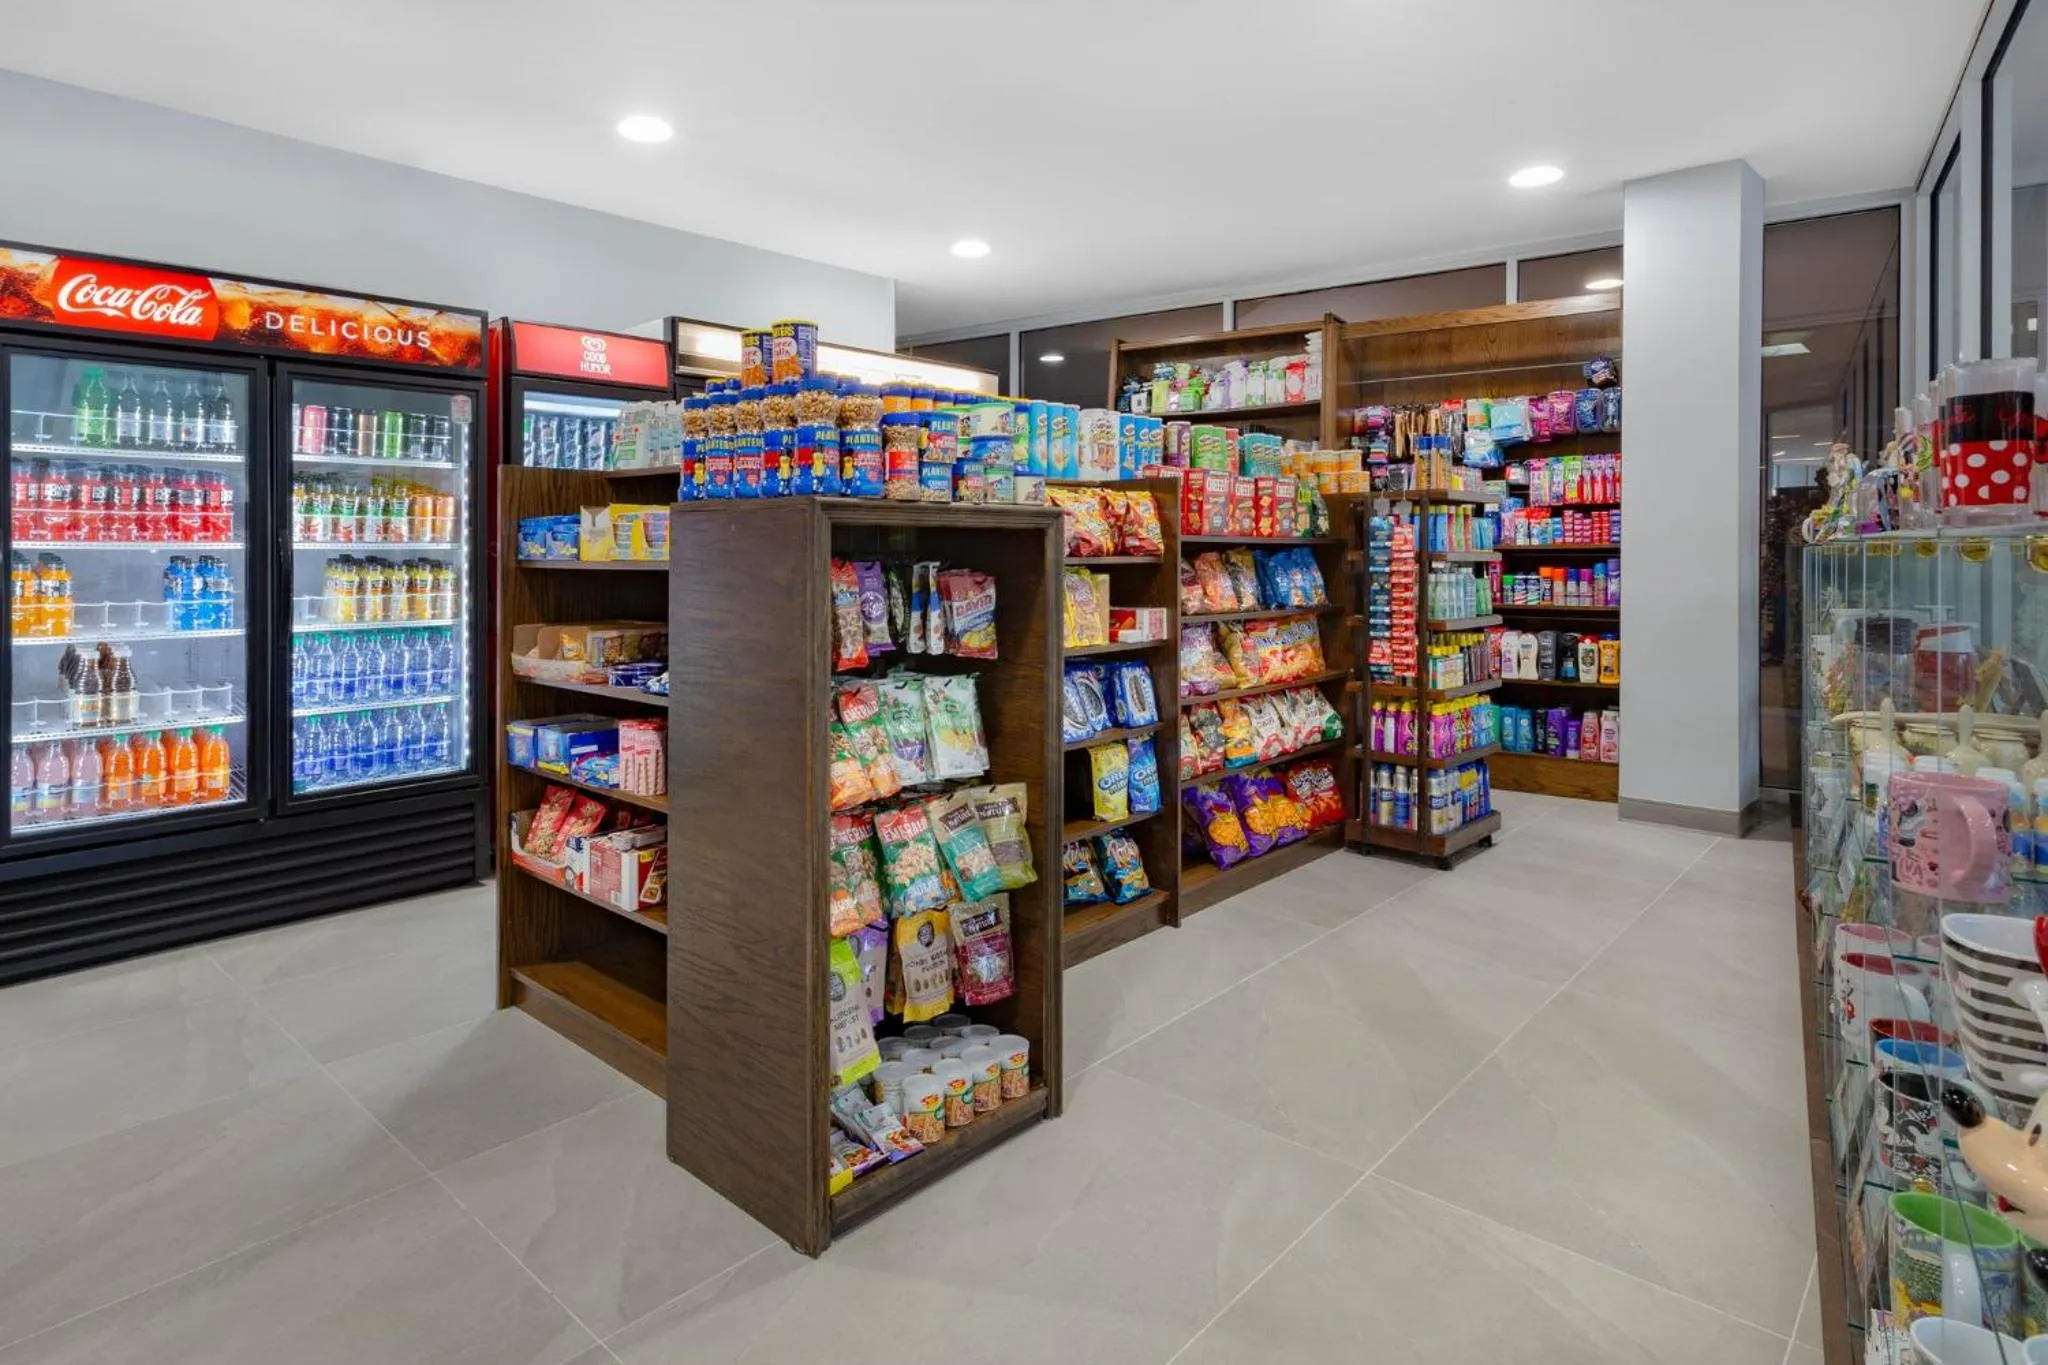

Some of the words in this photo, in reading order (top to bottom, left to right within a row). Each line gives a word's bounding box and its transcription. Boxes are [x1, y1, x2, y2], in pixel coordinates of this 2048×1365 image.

[57, 273, 212, 326] Coca-Cola
[264, 311, 432, 348] DELICIOUS
[579, 360, 613, 376] HUMOR
[583, 350, 607, 364] GOOD
[954, 594, 992, 618] DAVID
[884, 816, 929, 842] EMERALD
